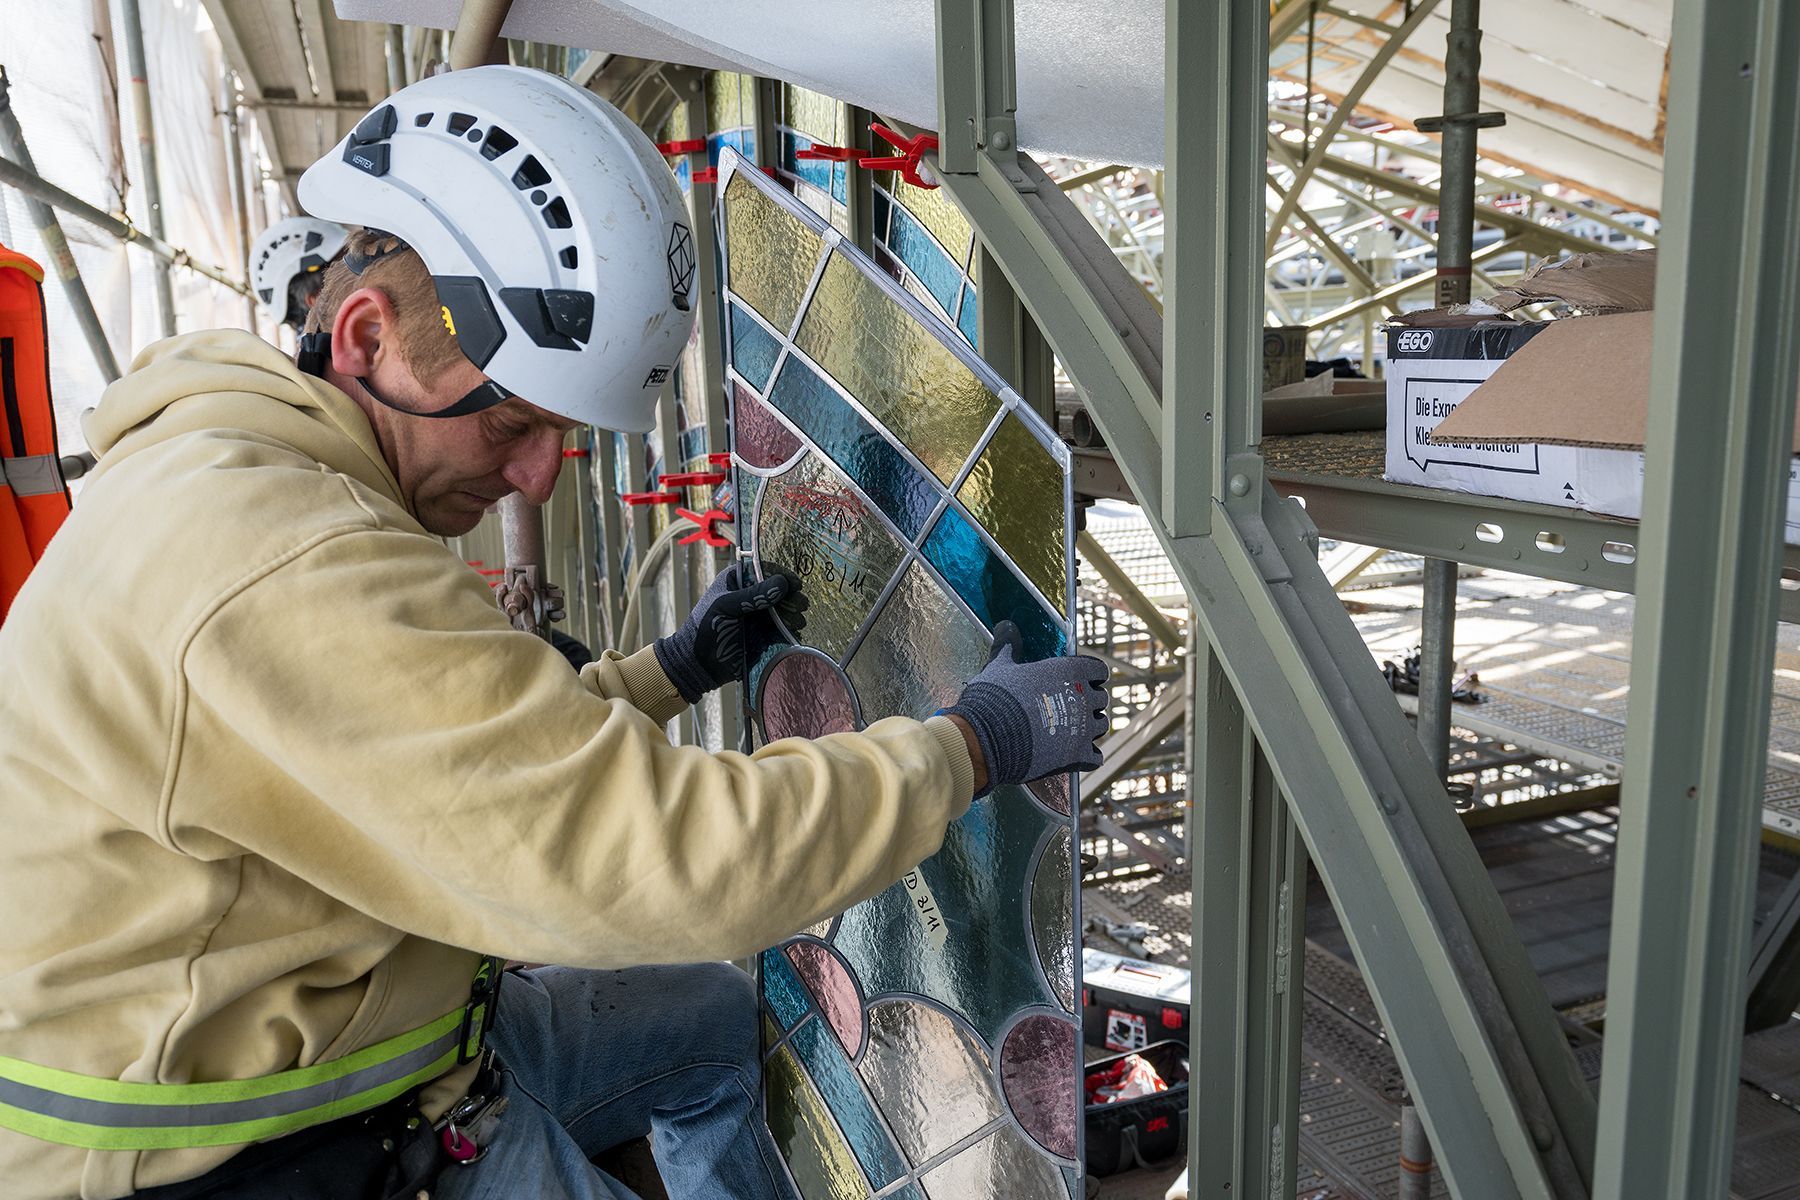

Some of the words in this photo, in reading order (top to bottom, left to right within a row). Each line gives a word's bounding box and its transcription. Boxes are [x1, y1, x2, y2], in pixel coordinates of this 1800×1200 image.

[352, 154, 374, 170] VERTEX
[1399, 332, 1431, 350] EGO
[1415, 397, 1430, 416] Die
